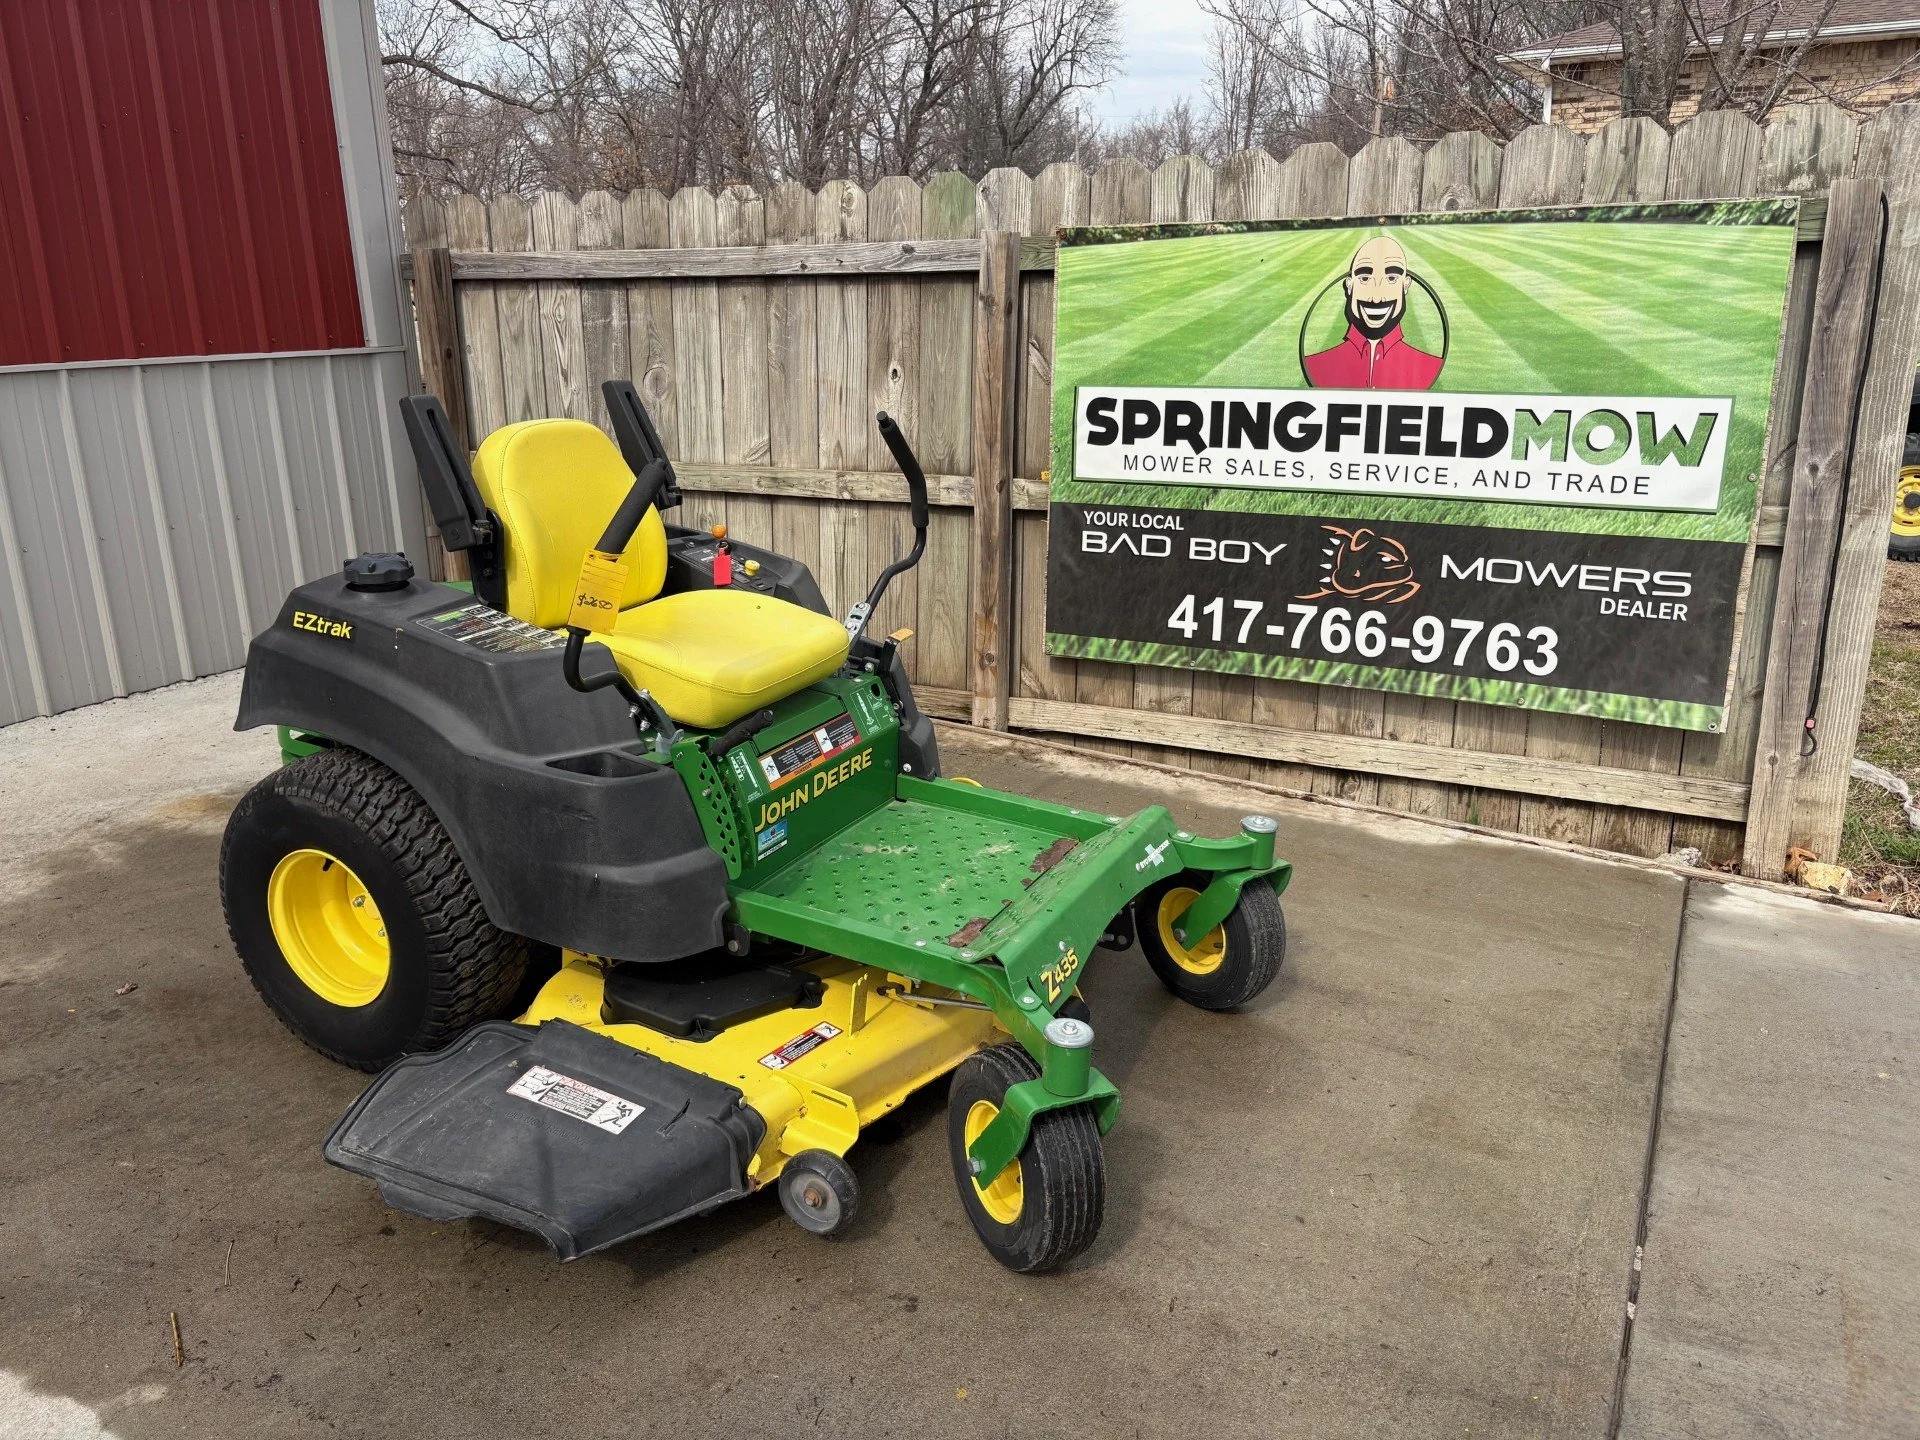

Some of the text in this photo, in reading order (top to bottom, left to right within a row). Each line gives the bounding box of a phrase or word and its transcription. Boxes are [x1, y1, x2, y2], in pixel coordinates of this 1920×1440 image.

[1086, 396, 1718, 467] SPRINGFIELDMOW
[1123, 454, 1651, 495] MOWER SALES, SERVICE, AND TRADE
[1083, 510, 1184, 531] YOUR LOCAL
[1081, 530, 1288, 565] BAD BOY
[1440, 554, 1692, 598] MOWERS
[293, 611, 353, 639] EZtrak
[1600, 597, 1689, 622] DEALER
[1167, 594, 1559, 677] 417-766-9763
[754, 783, 809, 833] JOHN
[813, 747, 873, 798] DEERE
[1040, 947, 1079, 1004] Z435
